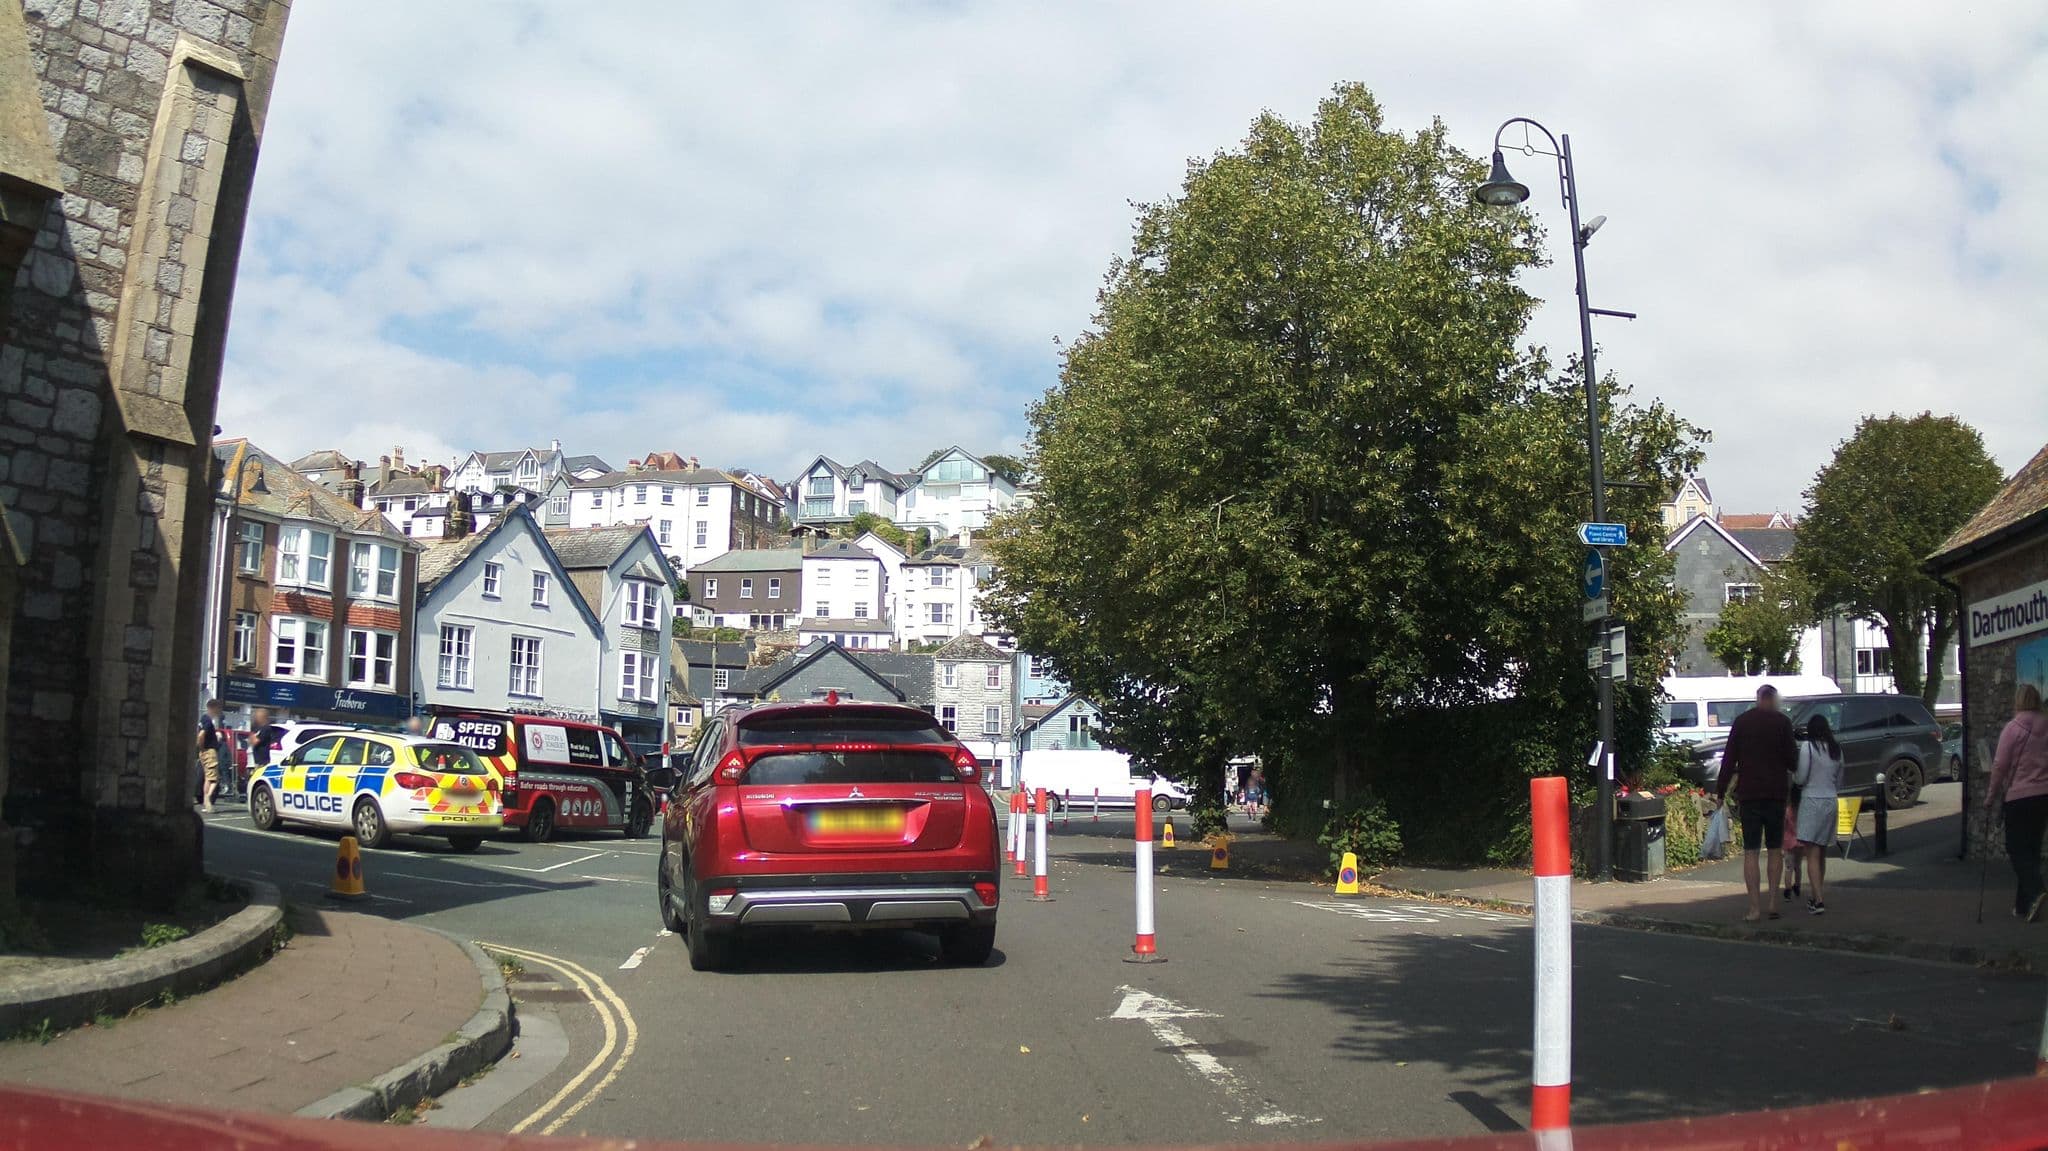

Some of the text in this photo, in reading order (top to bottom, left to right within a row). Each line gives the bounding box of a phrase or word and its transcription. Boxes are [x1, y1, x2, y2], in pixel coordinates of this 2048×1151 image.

[1973, 589, 2048, 639] Dartmouth
[458, 721, 502, 737] SPEED
[459, 735, 497, 750] KILLS
[520, 781, 534, 790] Safer
[549, 783, 567, 793] through
[567, 784, 588, 793] education
[282, 792, 343, 813] POLICE
[623, 781, 633, 824] FIRE
